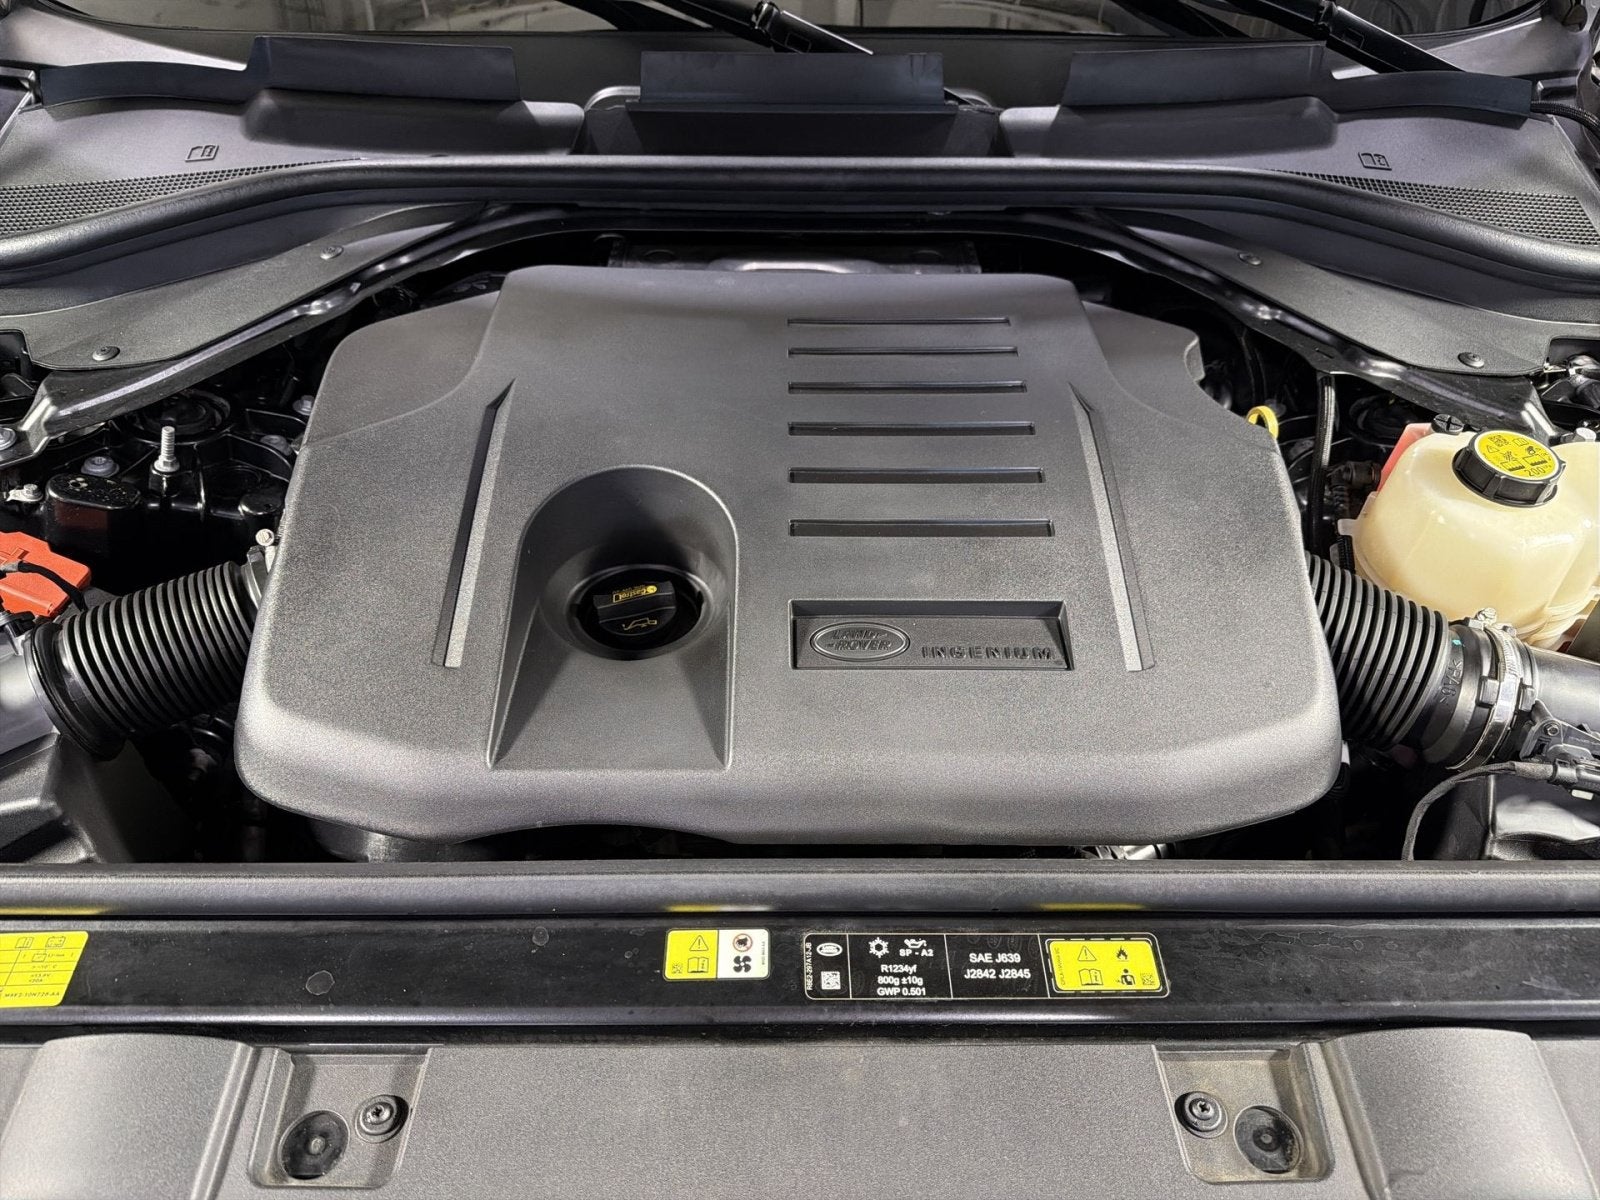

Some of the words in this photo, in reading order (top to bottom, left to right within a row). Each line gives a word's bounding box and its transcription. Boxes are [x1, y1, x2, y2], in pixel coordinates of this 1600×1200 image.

[619, 588, 646, 600] Castrol
[832, 629, 880, 640] LAND
[834, 639, 892, 651] ROVER
[921, 646, 1051, 660] INGENIUM
[899, 948, 912, 957] SP
[920, 948, 934, 957] A2
[969, 953, 993, 963] SAE
[995, 953, 1021, 963] J639
[880, 964, 918, 975] R1234yf
[964, 969, 996, 979] J2842
[999, 969, 1031, 979] J2845
[877, 975, 900, 986] 800g
[901, 975, 924, 986] ±10g
[876, 987, 901, 996] GWP
[902, 987, 926, 996] 0.501
